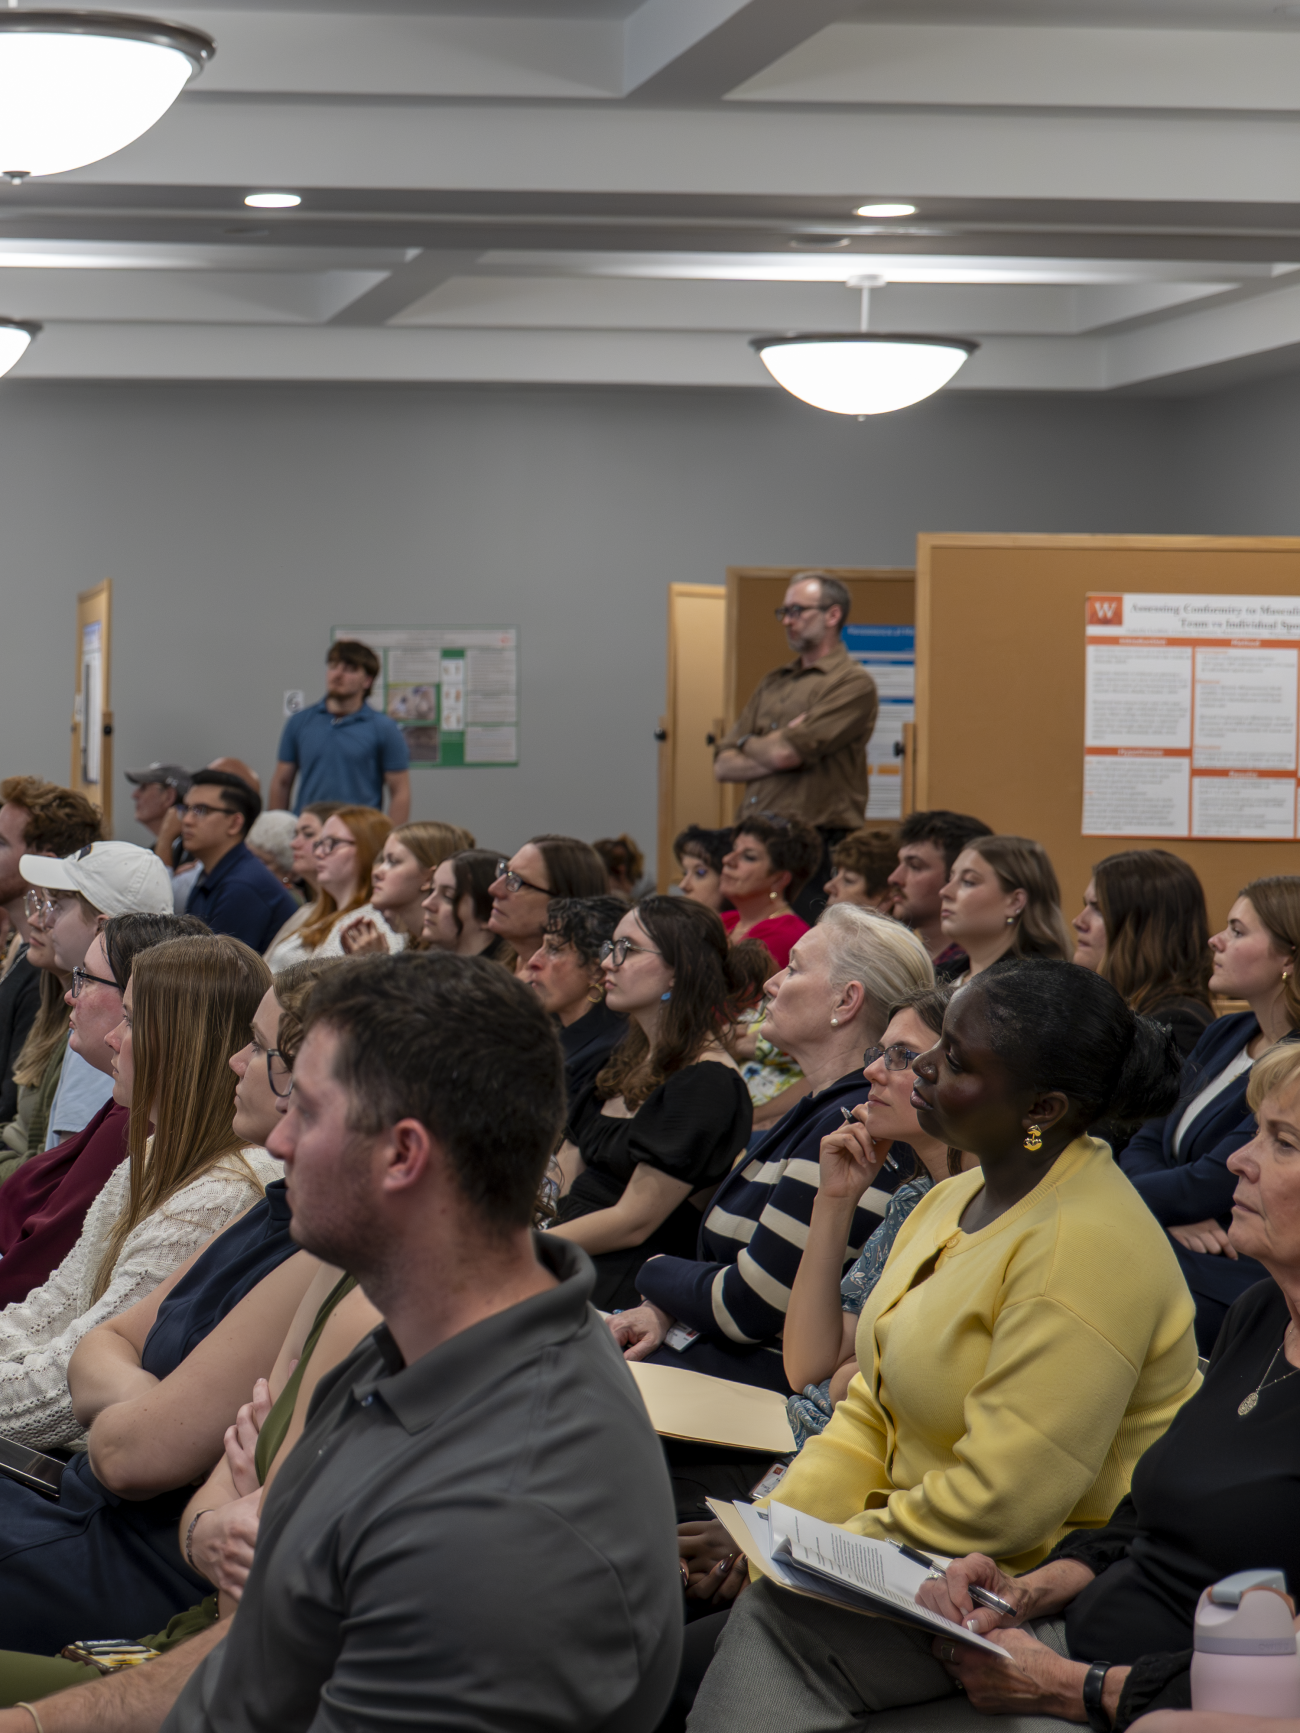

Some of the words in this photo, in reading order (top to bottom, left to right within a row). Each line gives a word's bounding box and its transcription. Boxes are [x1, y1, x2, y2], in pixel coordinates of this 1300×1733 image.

[1094, 601, 1117, 619] W
[1131, 603, 1181, 617] Assessing
[1182, 603, 1242, 618] Conformity
[1245, 605, 1256, 614] to
[1179, 617, 1208, 629] Team
[1225, 618, 1278, 630] Individual
